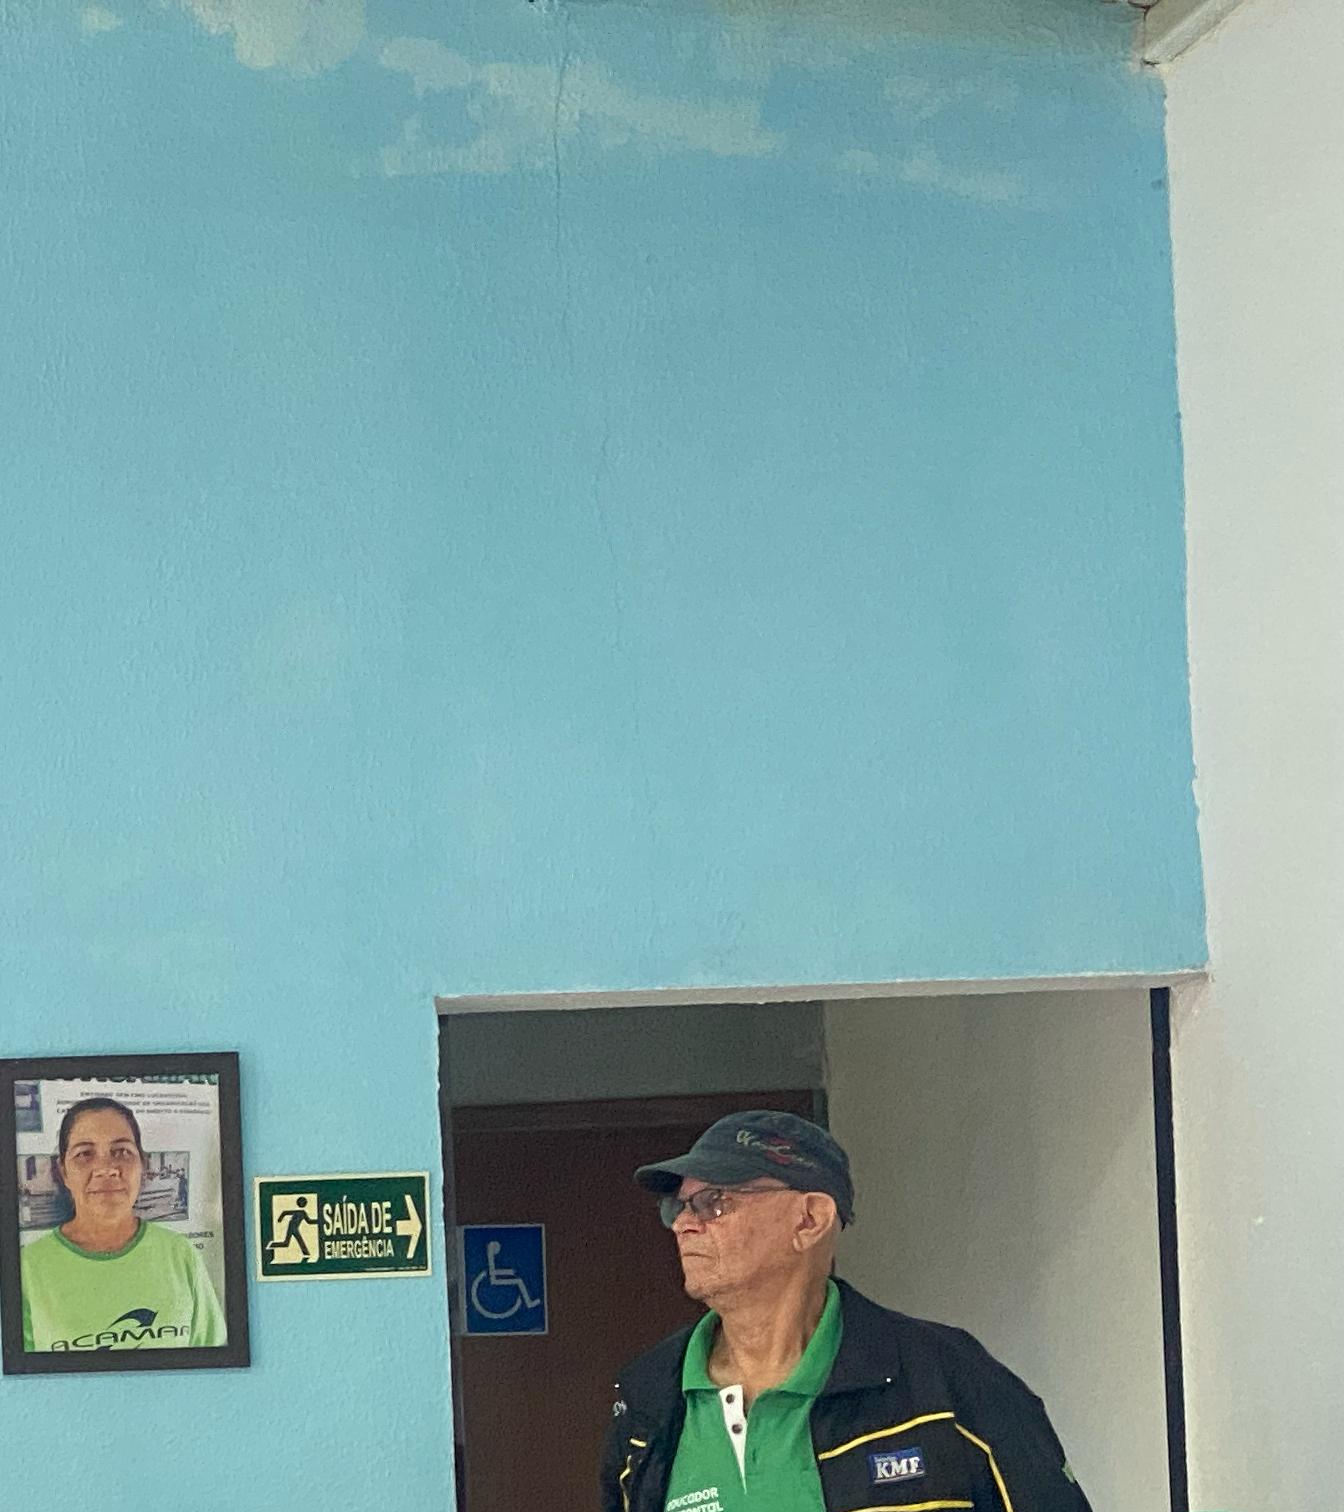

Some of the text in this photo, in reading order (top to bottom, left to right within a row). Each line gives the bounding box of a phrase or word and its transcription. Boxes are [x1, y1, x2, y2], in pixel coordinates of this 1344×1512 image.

[323, 1195, 392, 1236] SAÍDA DE
[324, 1236, 394, 1260] EMERGÊNCIA
[875, 1456, 920, 1478] KMF
